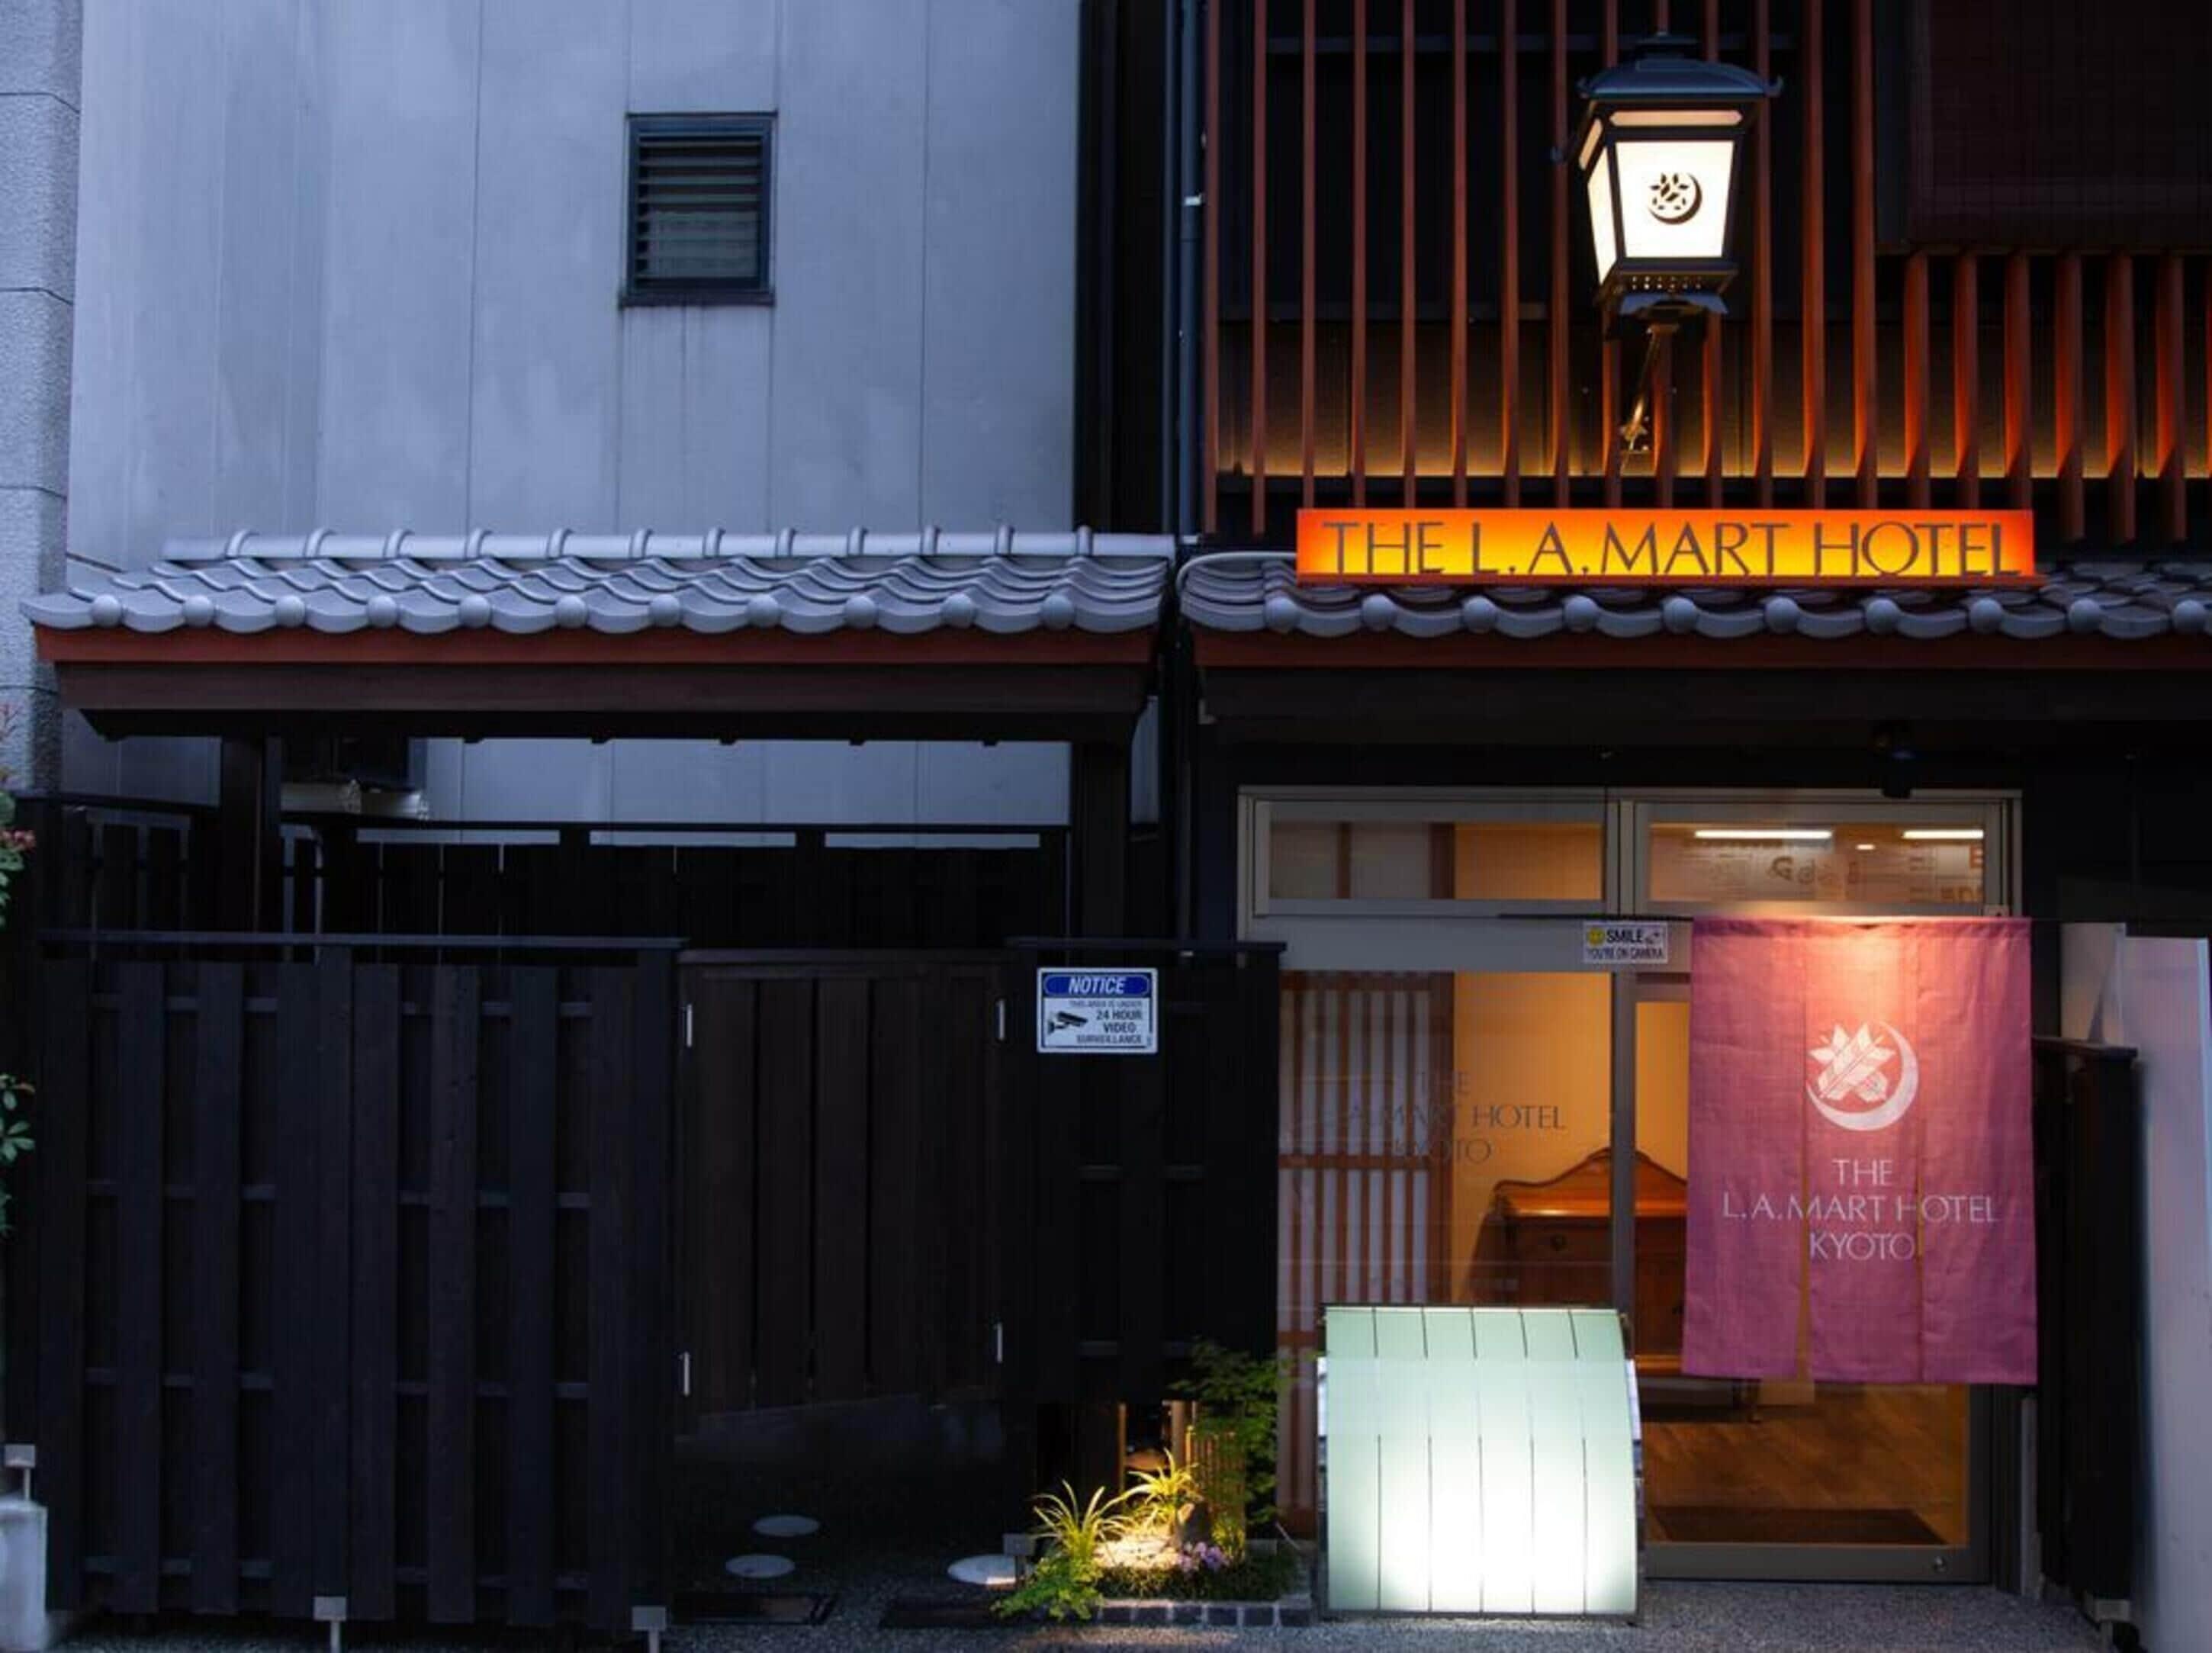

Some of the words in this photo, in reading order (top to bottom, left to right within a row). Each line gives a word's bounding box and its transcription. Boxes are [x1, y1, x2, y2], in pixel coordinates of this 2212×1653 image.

[1322, 521, 1445, 574] THE
[1814, 520, 2022, 576] HOTEL
[1606, 928, 1642, 944] SMILE
[1068, 976, 1127, 995] NOTICE
[1096, 1009, 1110, 1021] 24
[1112, 1009, 1142, 1020] HOUR
[1102, 1021, 1137, 1033] VIDEO
[1076, 1034, 1142, 1044] SURVEILLANCE
[1472, 1103, 1566, 1129] HOTEL
[1832, 1158, 1893, 1187] THE
[1895, 1195, 1995, 1224] HOTEL
[1809, 1231, 1916, 1261] KYOTO
